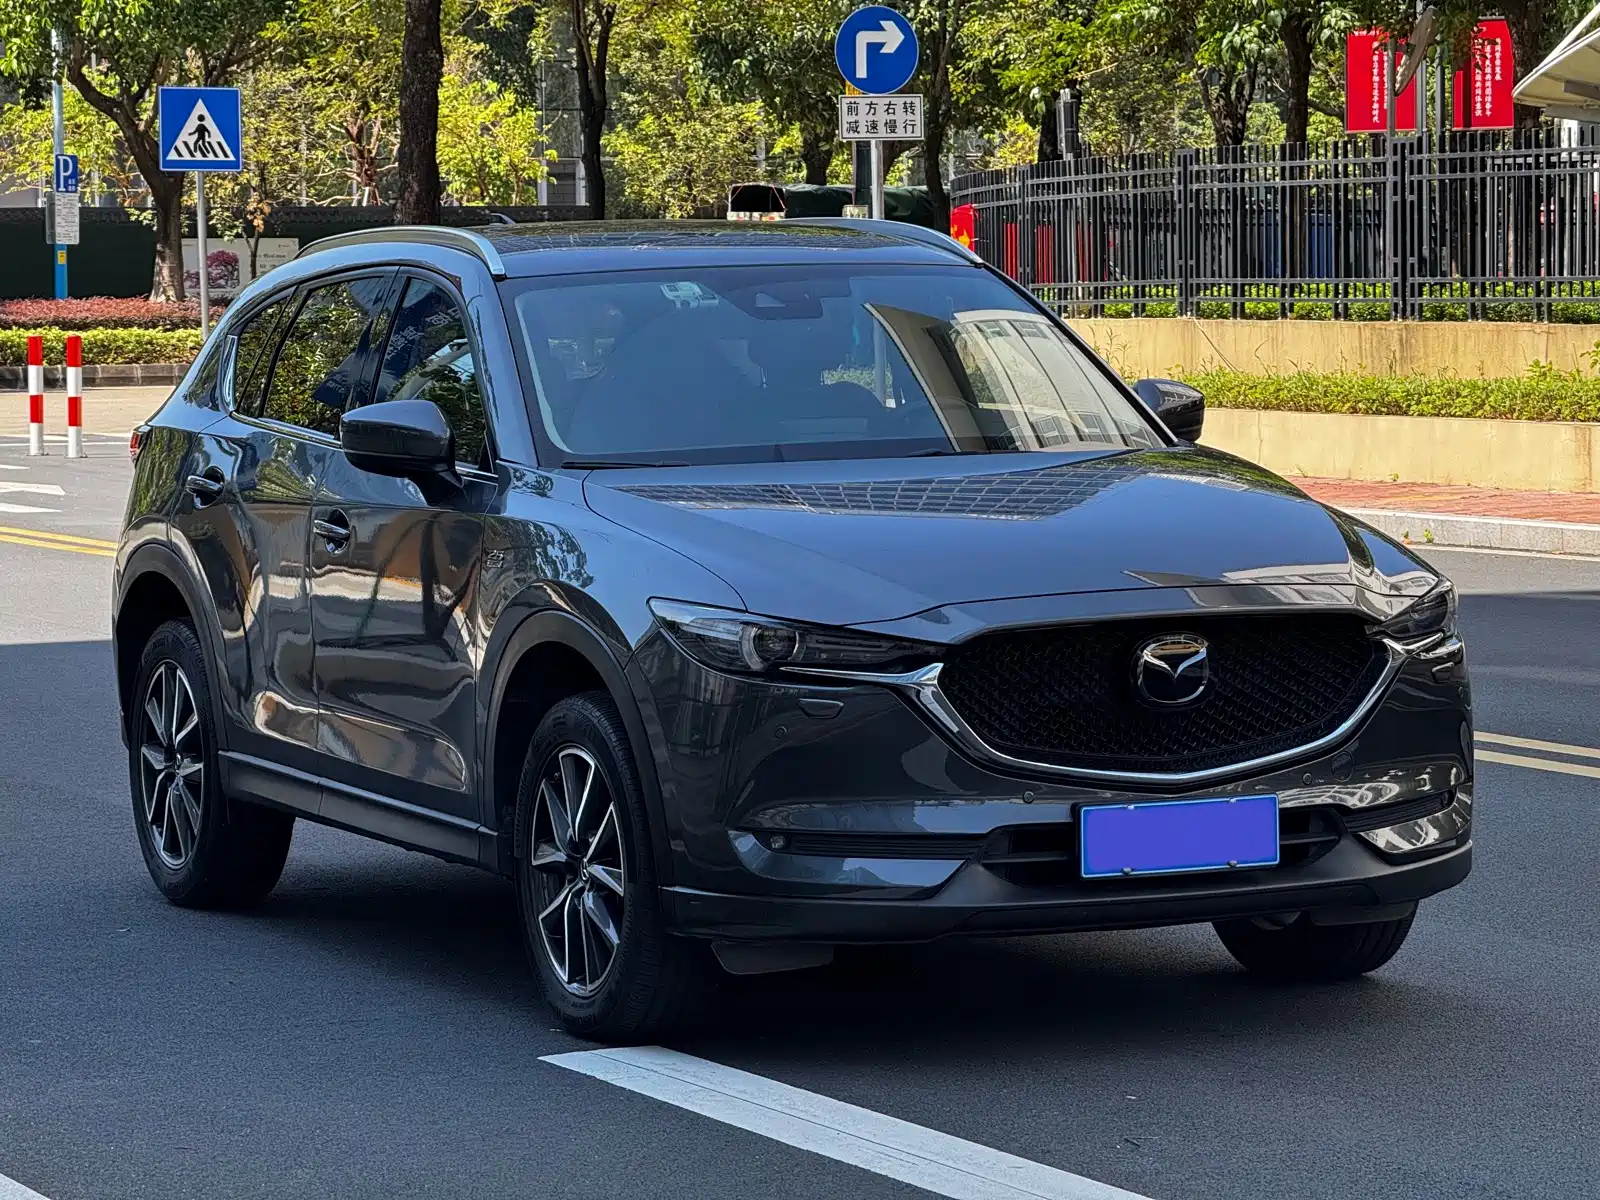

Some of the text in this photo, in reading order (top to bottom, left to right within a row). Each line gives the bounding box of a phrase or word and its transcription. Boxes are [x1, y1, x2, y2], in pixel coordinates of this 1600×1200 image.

[845, 100, 917, 116] 前方右转
[845, 119, 917, 135] 减速慢行
[57, 155, 73, 191] P
